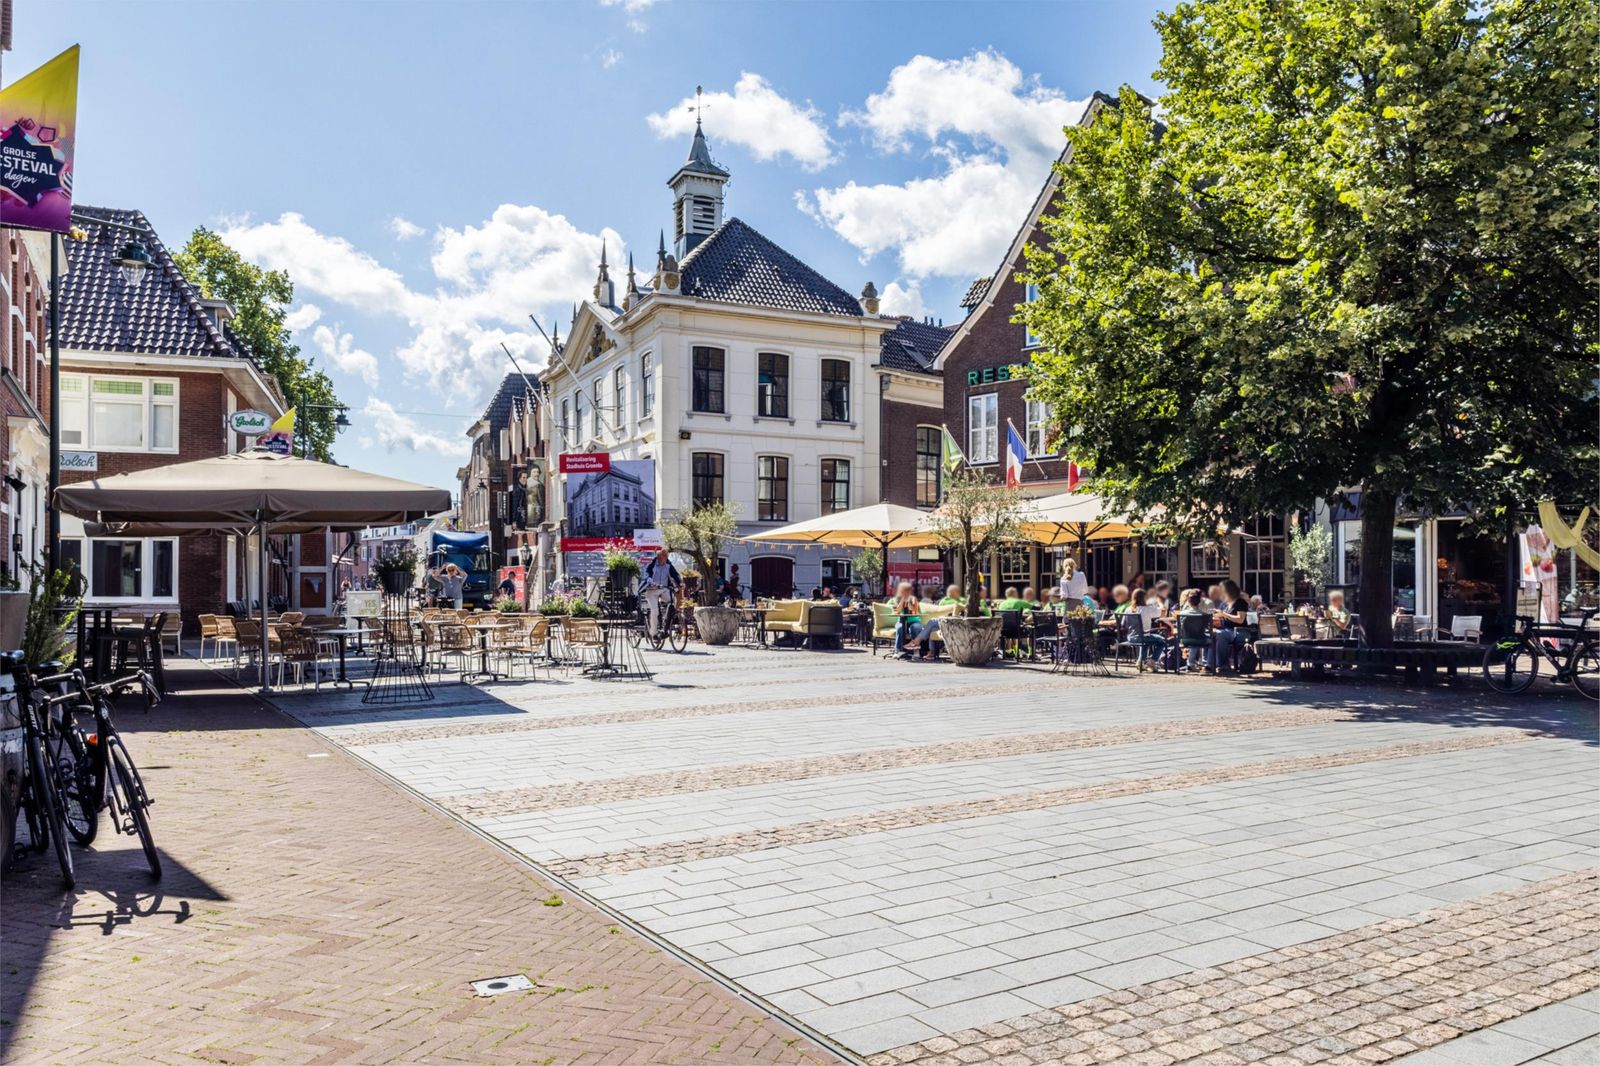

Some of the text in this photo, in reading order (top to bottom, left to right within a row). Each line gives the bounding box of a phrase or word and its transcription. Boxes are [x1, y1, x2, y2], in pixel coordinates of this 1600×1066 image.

[3, 146, 37, 160] GROLSE
[4, 166, 38, 189] dagen
[235, 416, 266, 428] Grolsch
